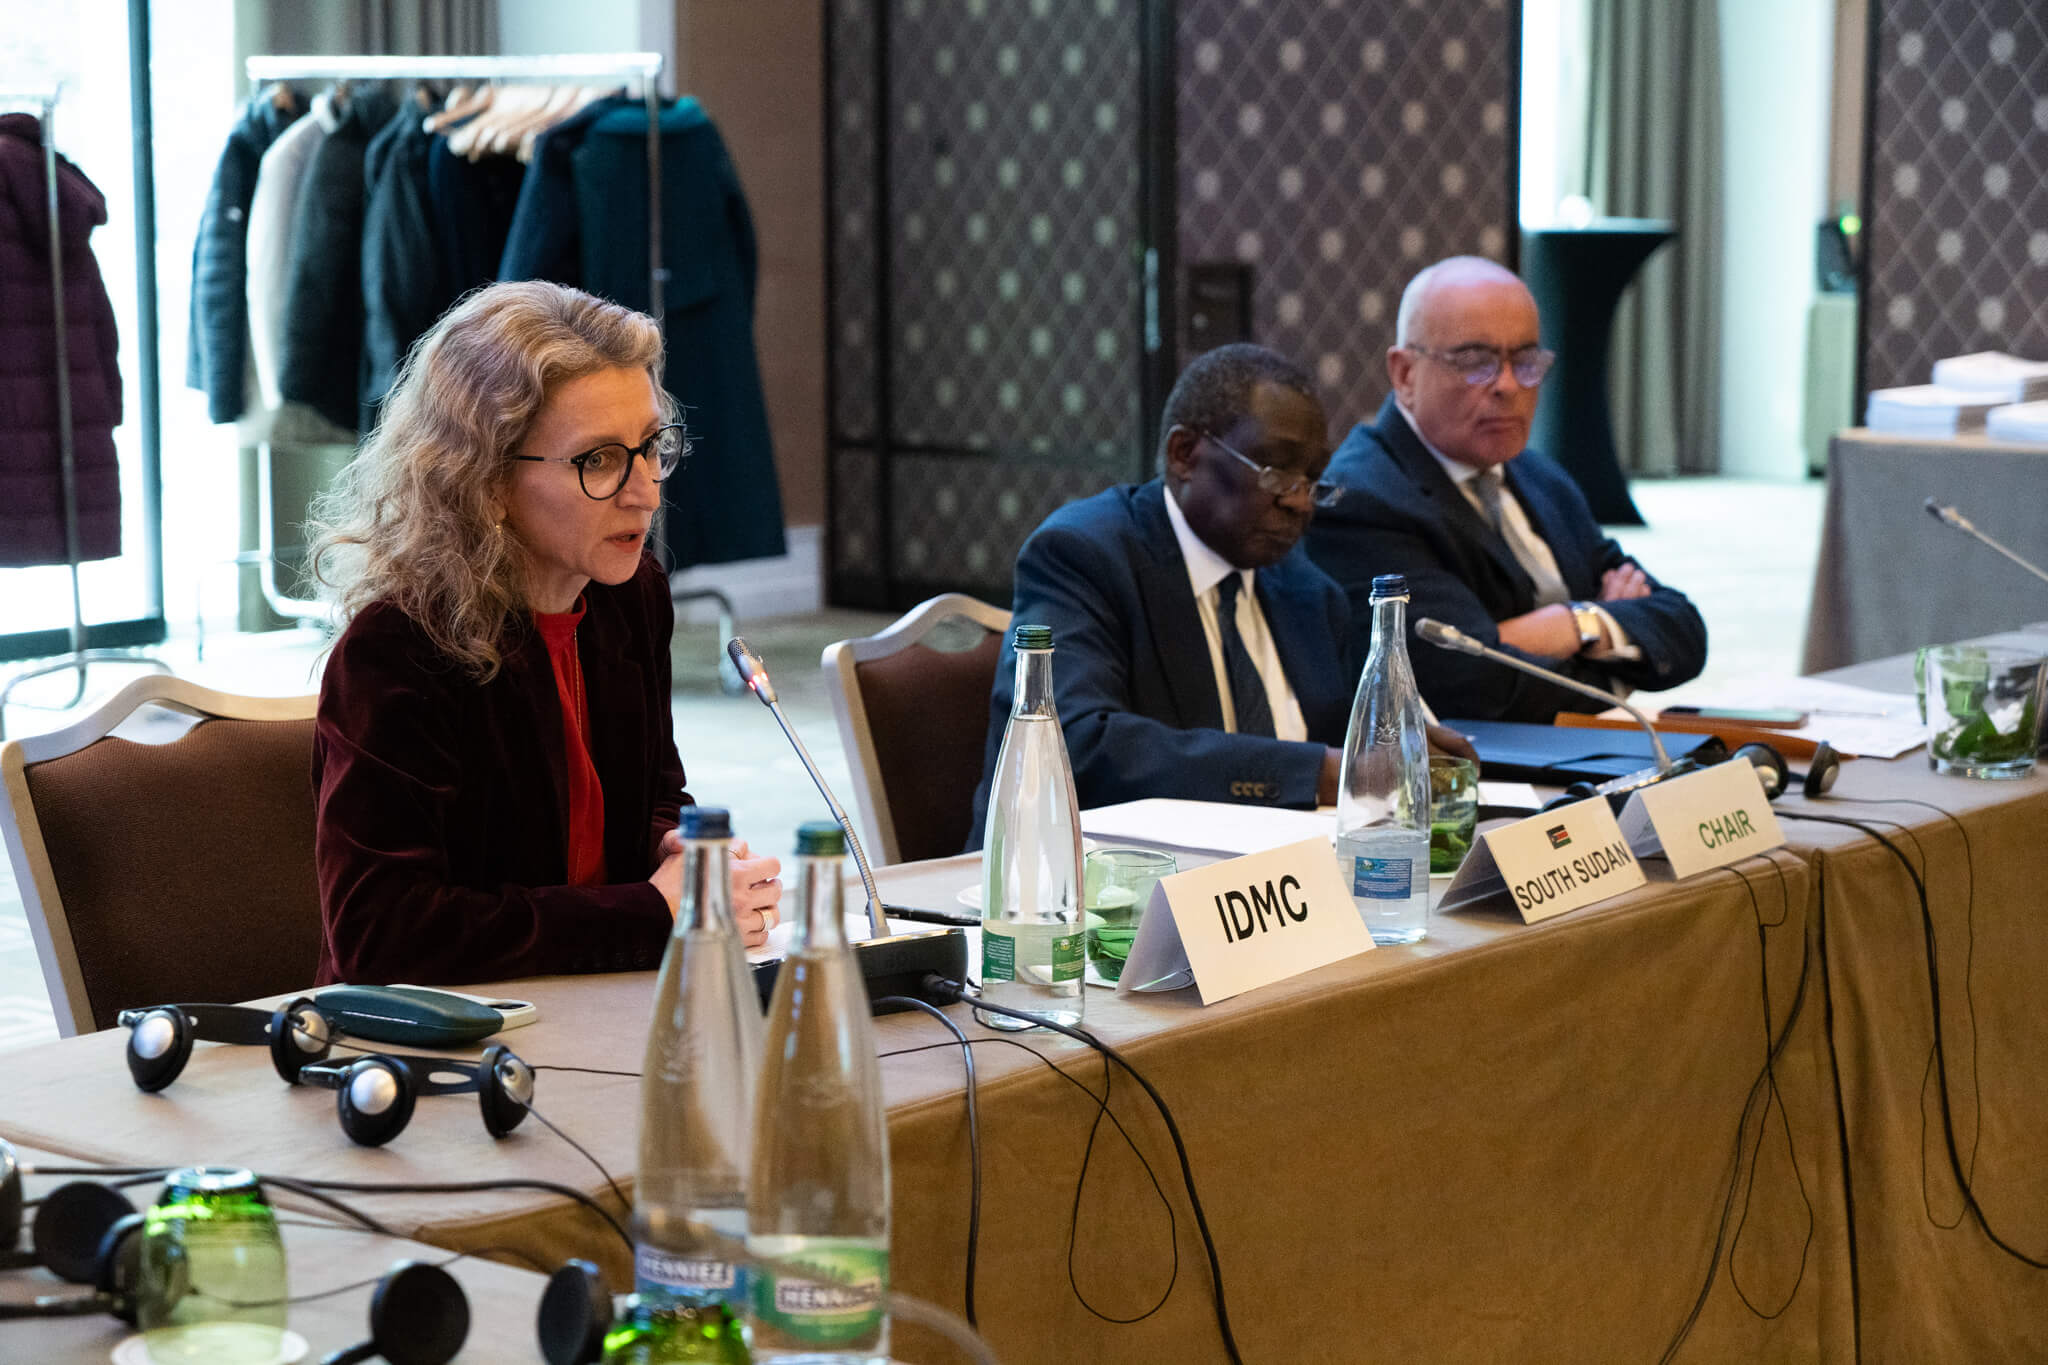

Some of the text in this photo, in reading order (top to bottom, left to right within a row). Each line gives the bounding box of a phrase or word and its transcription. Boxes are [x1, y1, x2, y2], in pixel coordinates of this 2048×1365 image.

[1699, 809, 1757, 850] CHAIR
[1214, 874, 1308, 943] IDMC
[1514, 840, 1632, 911] SOUTH SUDAN
